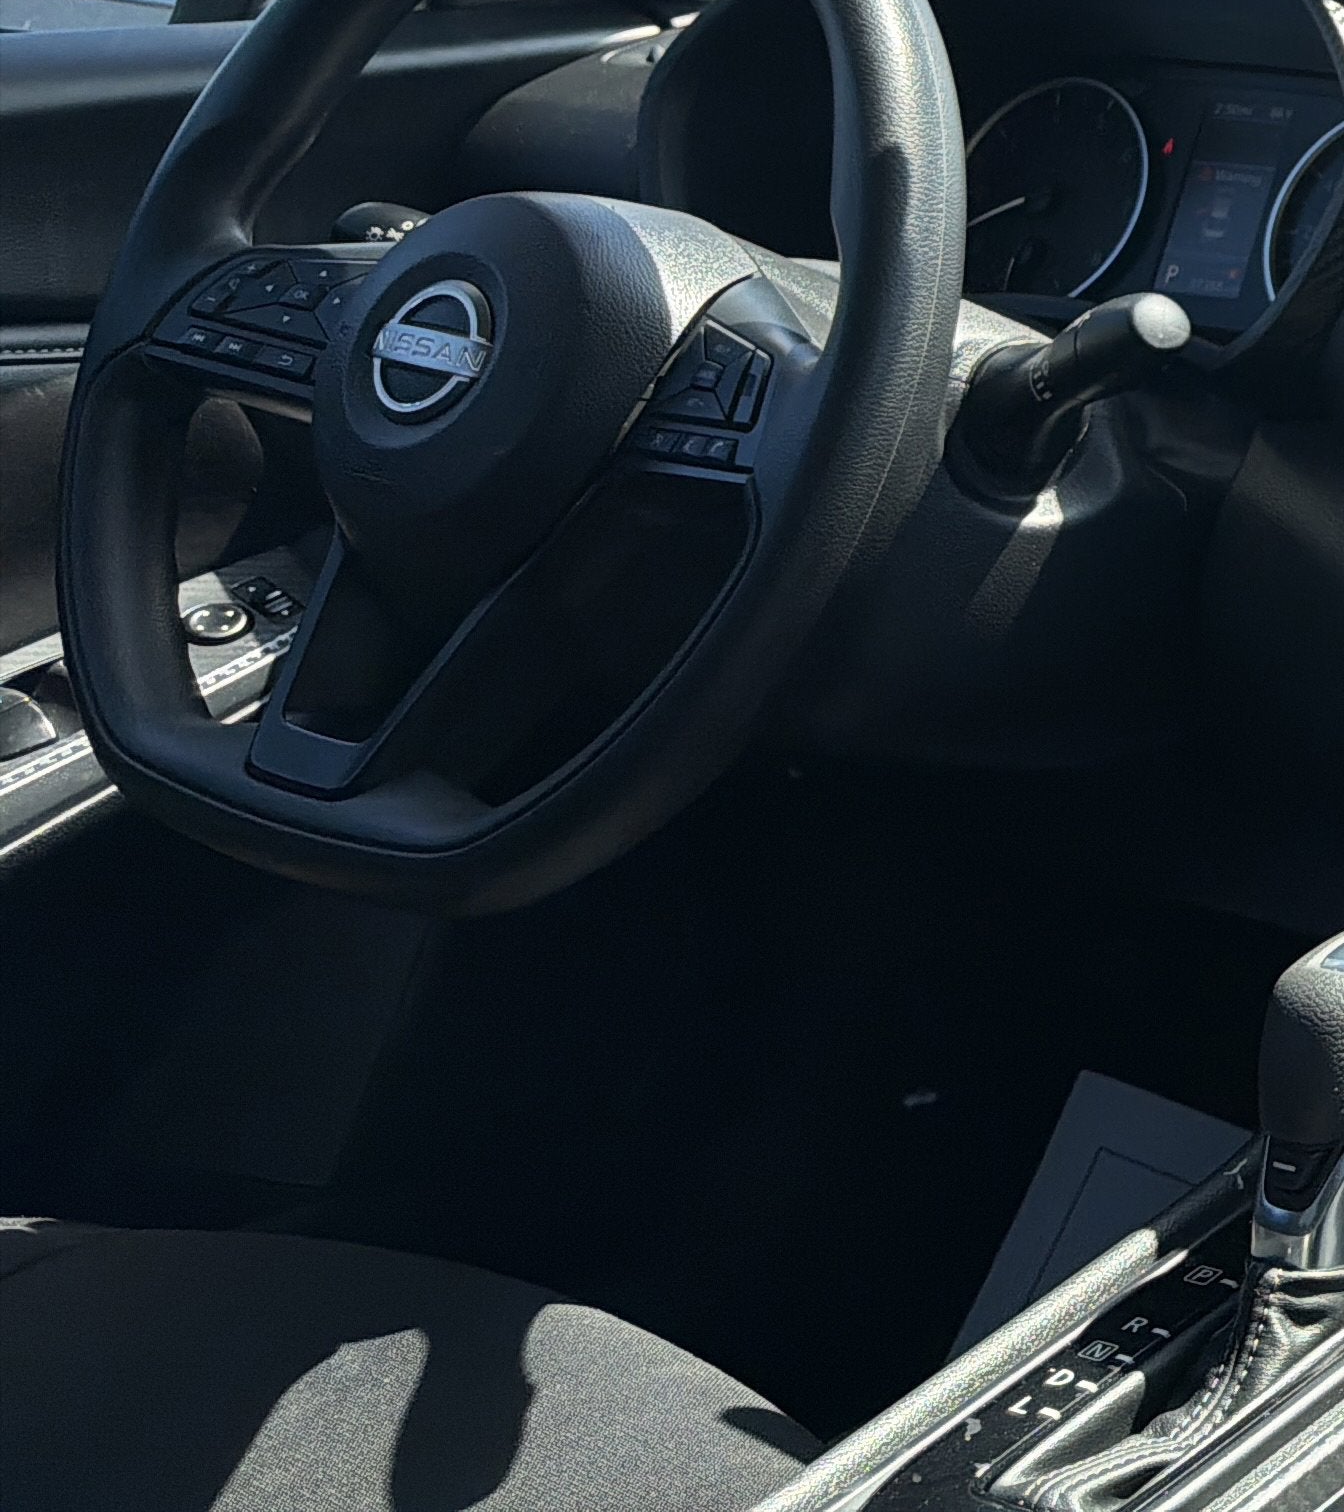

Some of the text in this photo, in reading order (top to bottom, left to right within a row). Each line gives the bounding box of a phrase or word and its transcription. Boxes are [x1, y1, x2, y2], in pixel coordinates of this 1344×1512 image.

[372, 329, 488, 372] NISSAN
[1121, 1316, 1148, 1334] R
[1088, 1343, 1110, 1358] N
[1045, 1369, 1075, 1386] D
[1008, 1395, 1032, 1414] L
